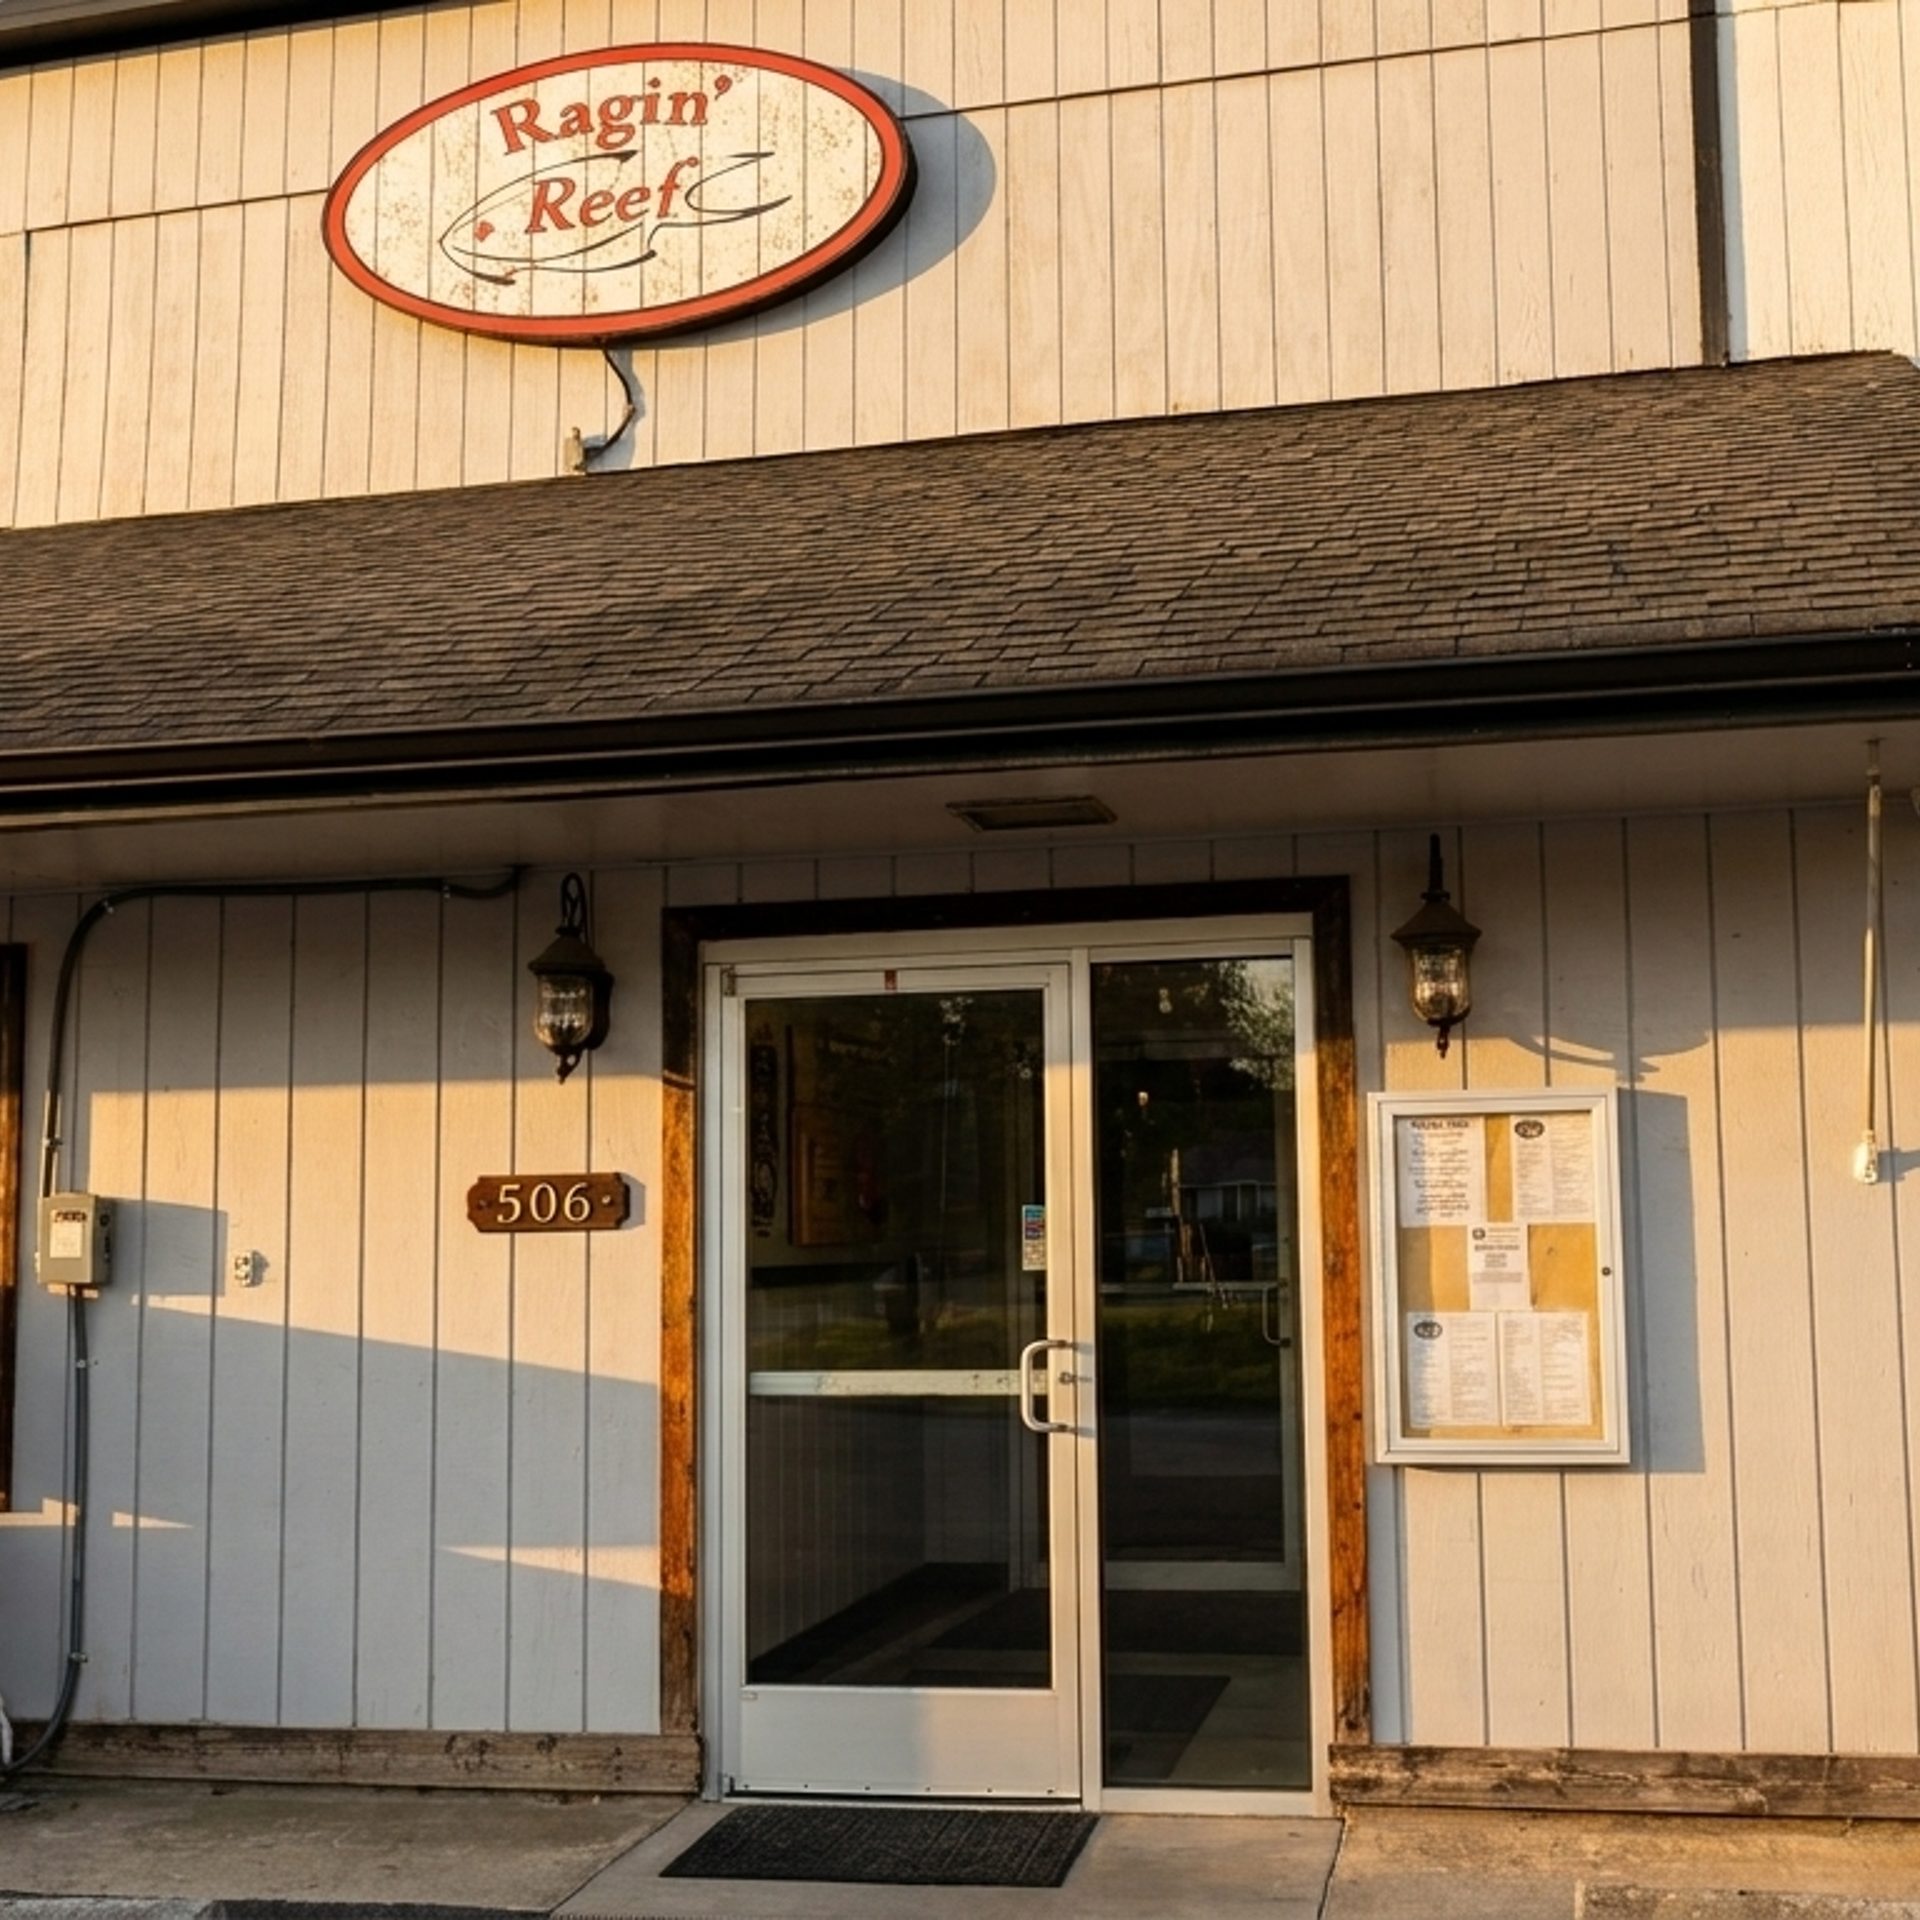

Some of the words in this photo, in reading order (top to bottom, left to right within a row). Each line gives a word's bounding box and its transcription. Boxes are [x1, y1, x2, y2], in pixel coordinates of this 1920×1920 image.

[490, 74, 733, 156] Ragin'
[525, 156, 699, 234] Reef
[497, 1182, 591, 1224] 506
